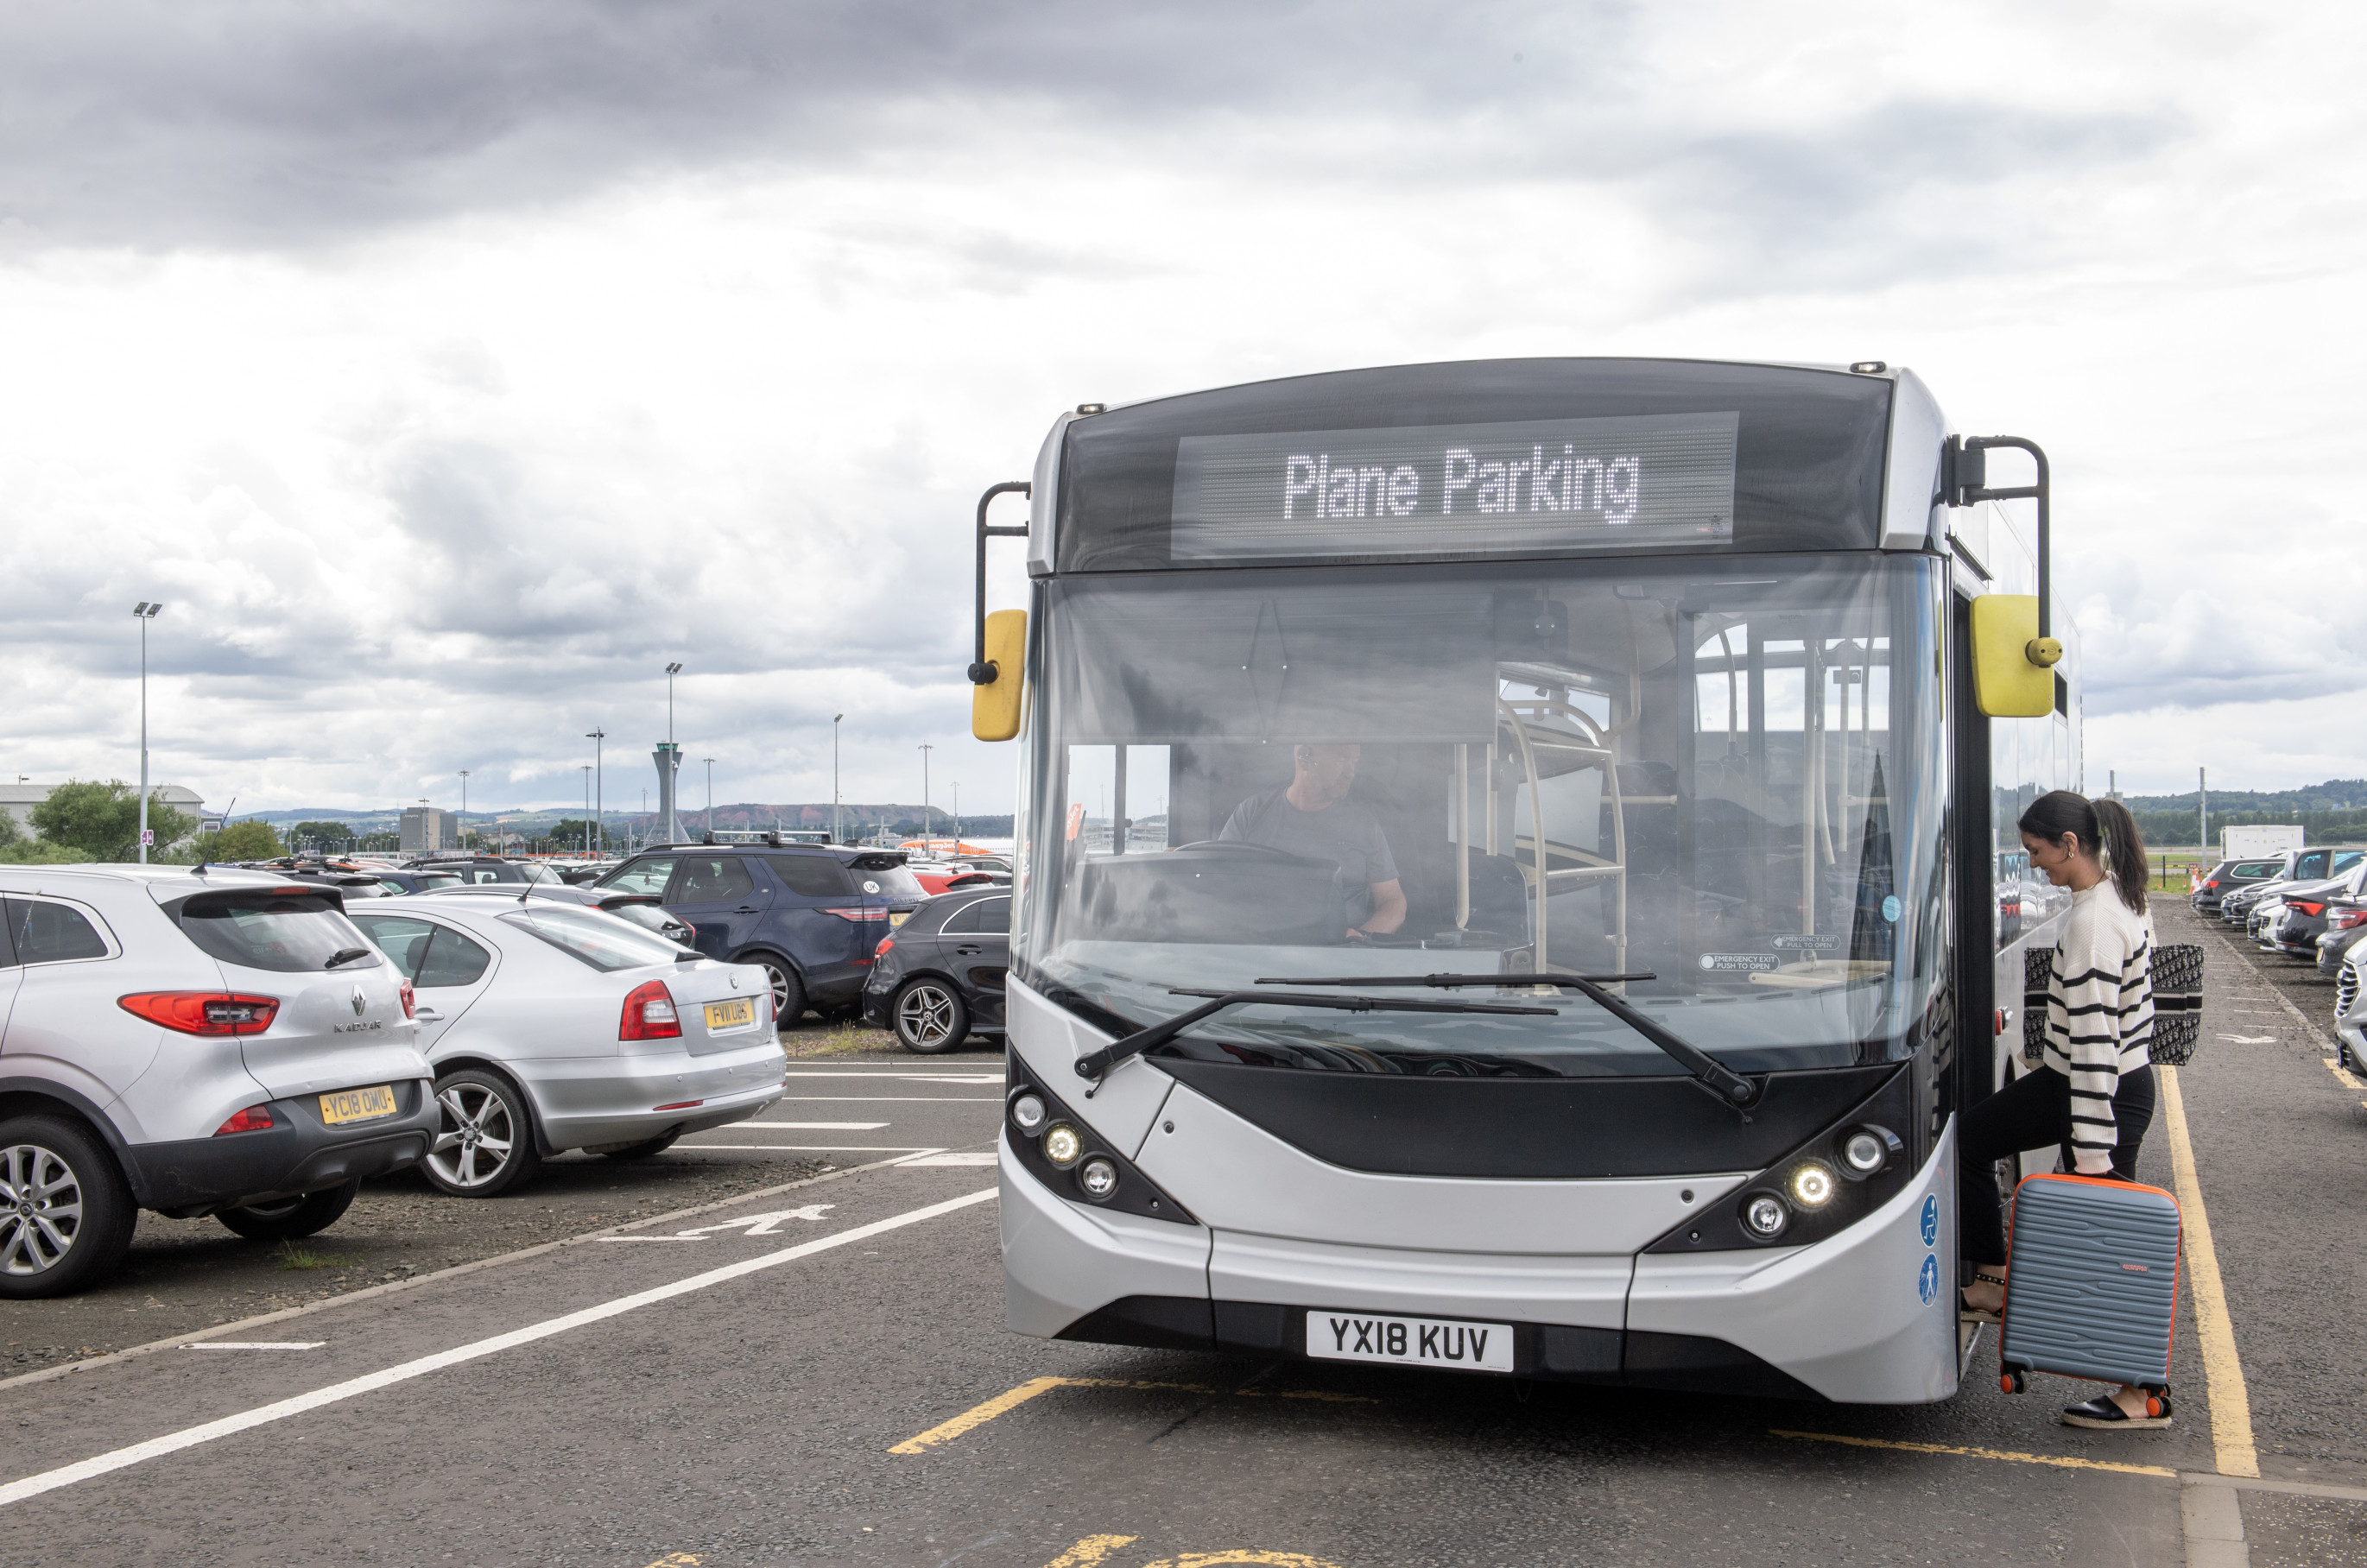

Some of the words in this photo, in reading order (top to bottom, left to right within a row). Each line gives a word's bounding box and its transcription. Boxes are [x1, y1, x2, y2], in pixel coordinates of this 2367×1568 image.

[1284, 454, 1419, 519] Plane
[1443, 444, 1639, 524] Parking
[865, 882, 878, 892] UK
[334, 1021, 382, 1034] KADJAR
[328, 1093, 361, 1118] YC18
[362, 1089, 389, 1113] OMU
[1330, 1318, 1408, 1356] YX18
[1419, 1324, 1489, 1363] KUV
